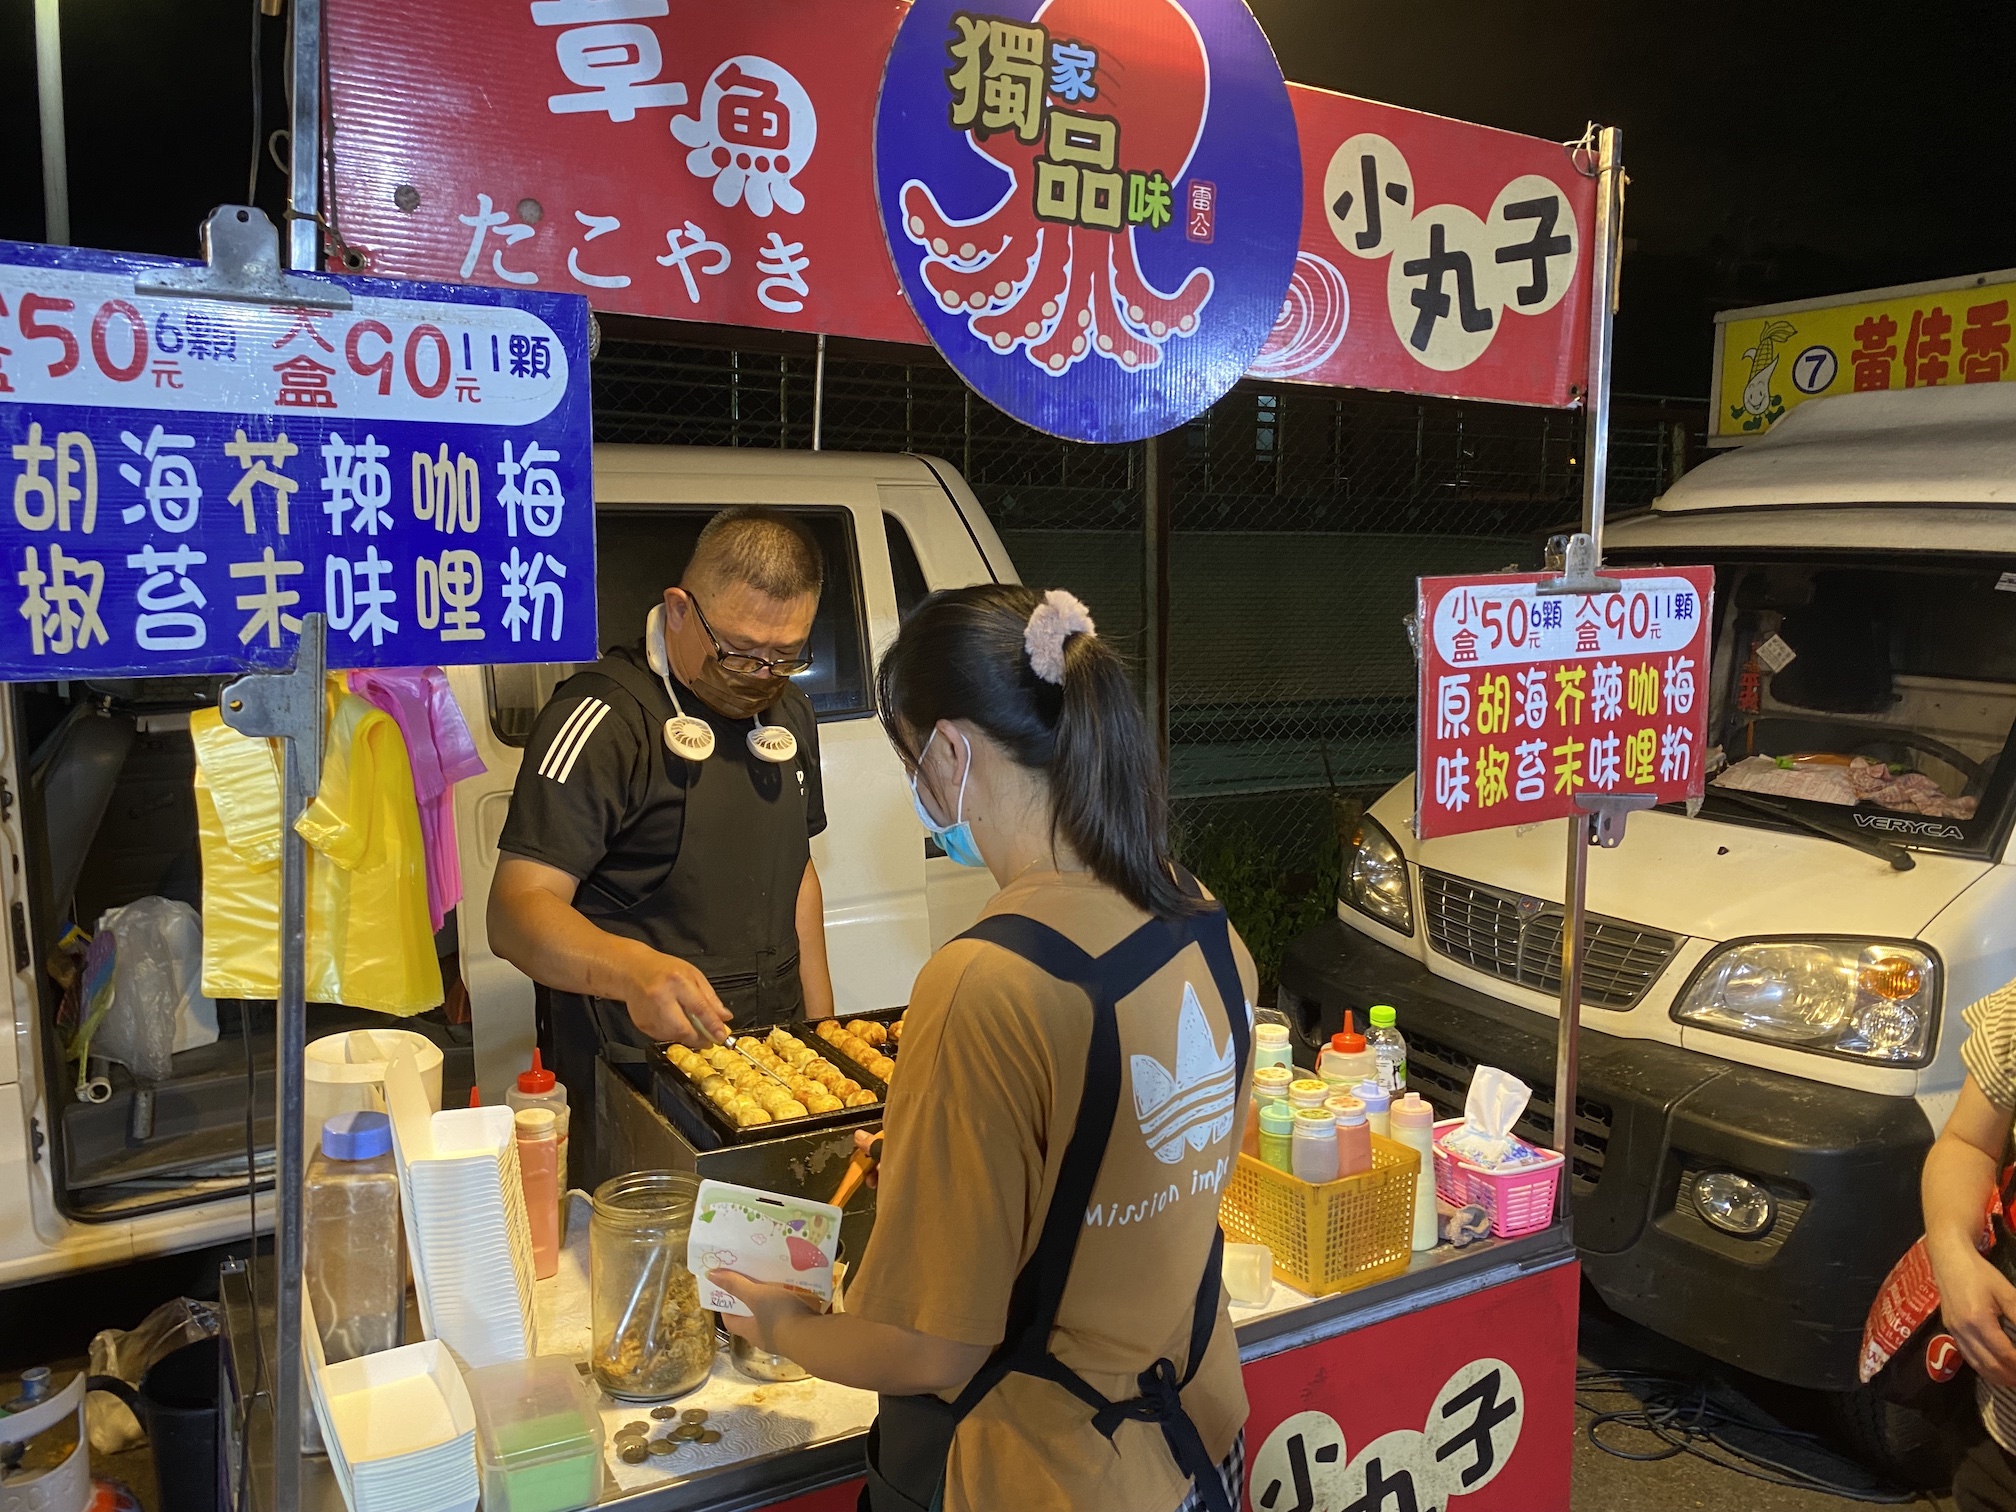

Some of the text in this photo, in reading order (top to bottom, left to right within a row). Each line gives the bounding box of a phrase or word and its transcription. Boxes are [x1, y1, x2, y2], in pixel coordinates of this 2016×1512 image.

[1190, 184, 1212, 237] 雷公
[458, 193, 810, 313] たこやき
[1332, 154, 1572, 352] 小丸子
[1804, 354, 1828, 389] 7
[1853, 813, 1965, 840] VERYCA
